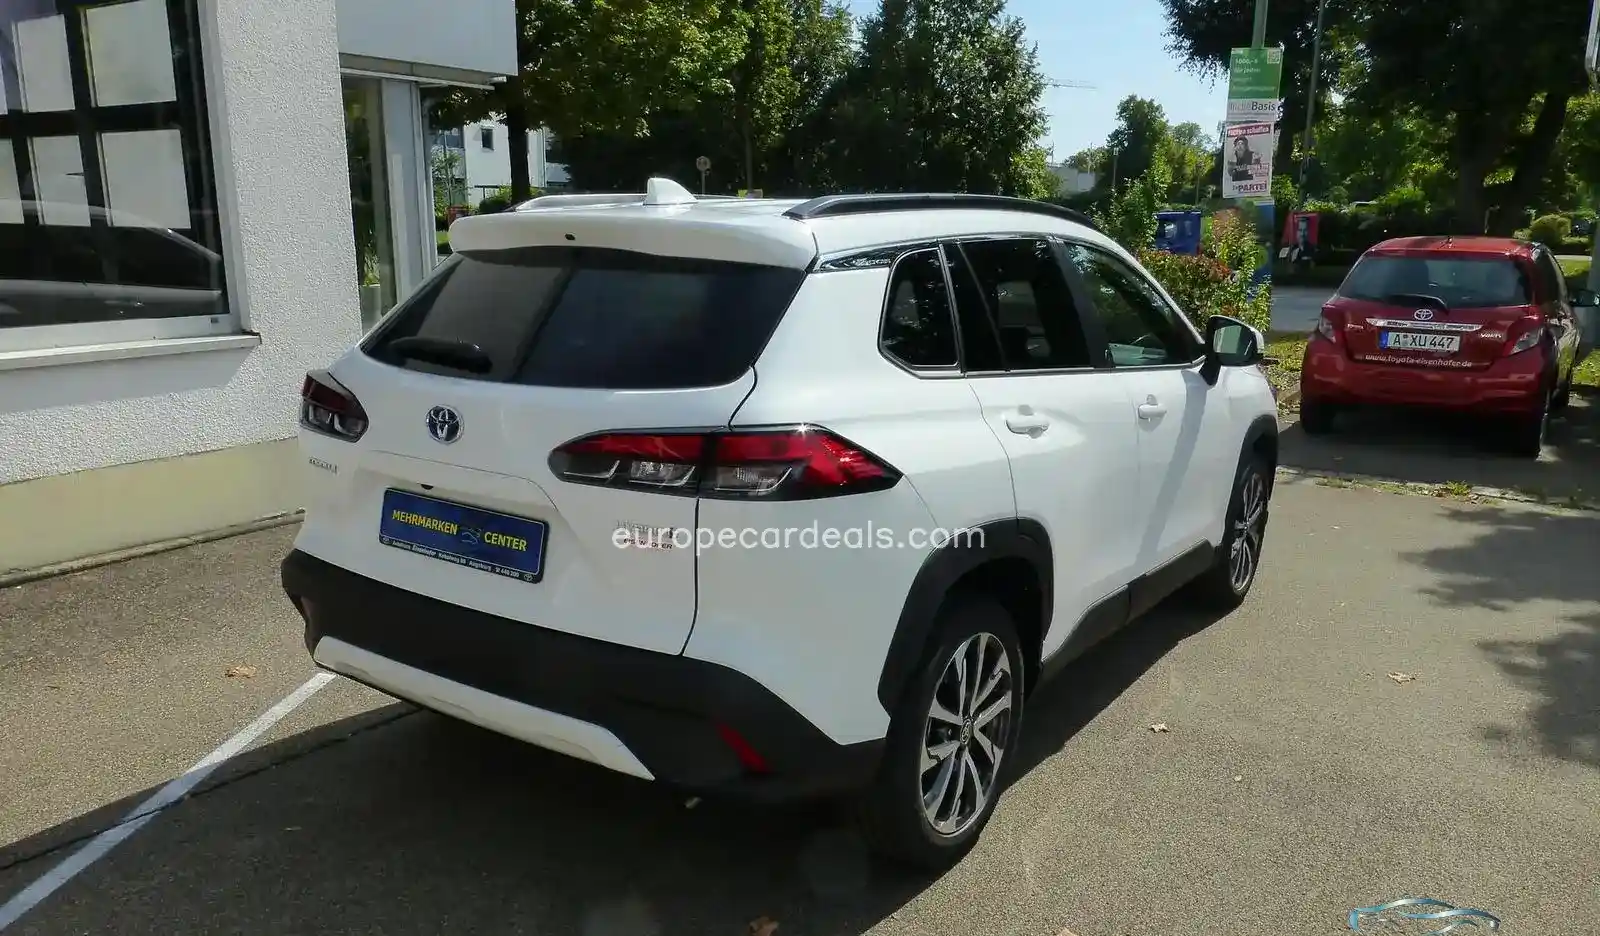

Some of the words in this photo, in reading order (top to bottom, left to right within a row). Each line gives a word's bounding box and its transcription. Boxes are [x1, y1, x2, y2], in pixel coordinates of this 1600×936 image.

[1393, 334, 1400, 346] A
[1409, 335, 1427, 347] XU
[1429, 336, 1454, 349] 447
[392, 509, 458, 536] MEHRMARKEN
[484, 531, 527, 552] CENTER
